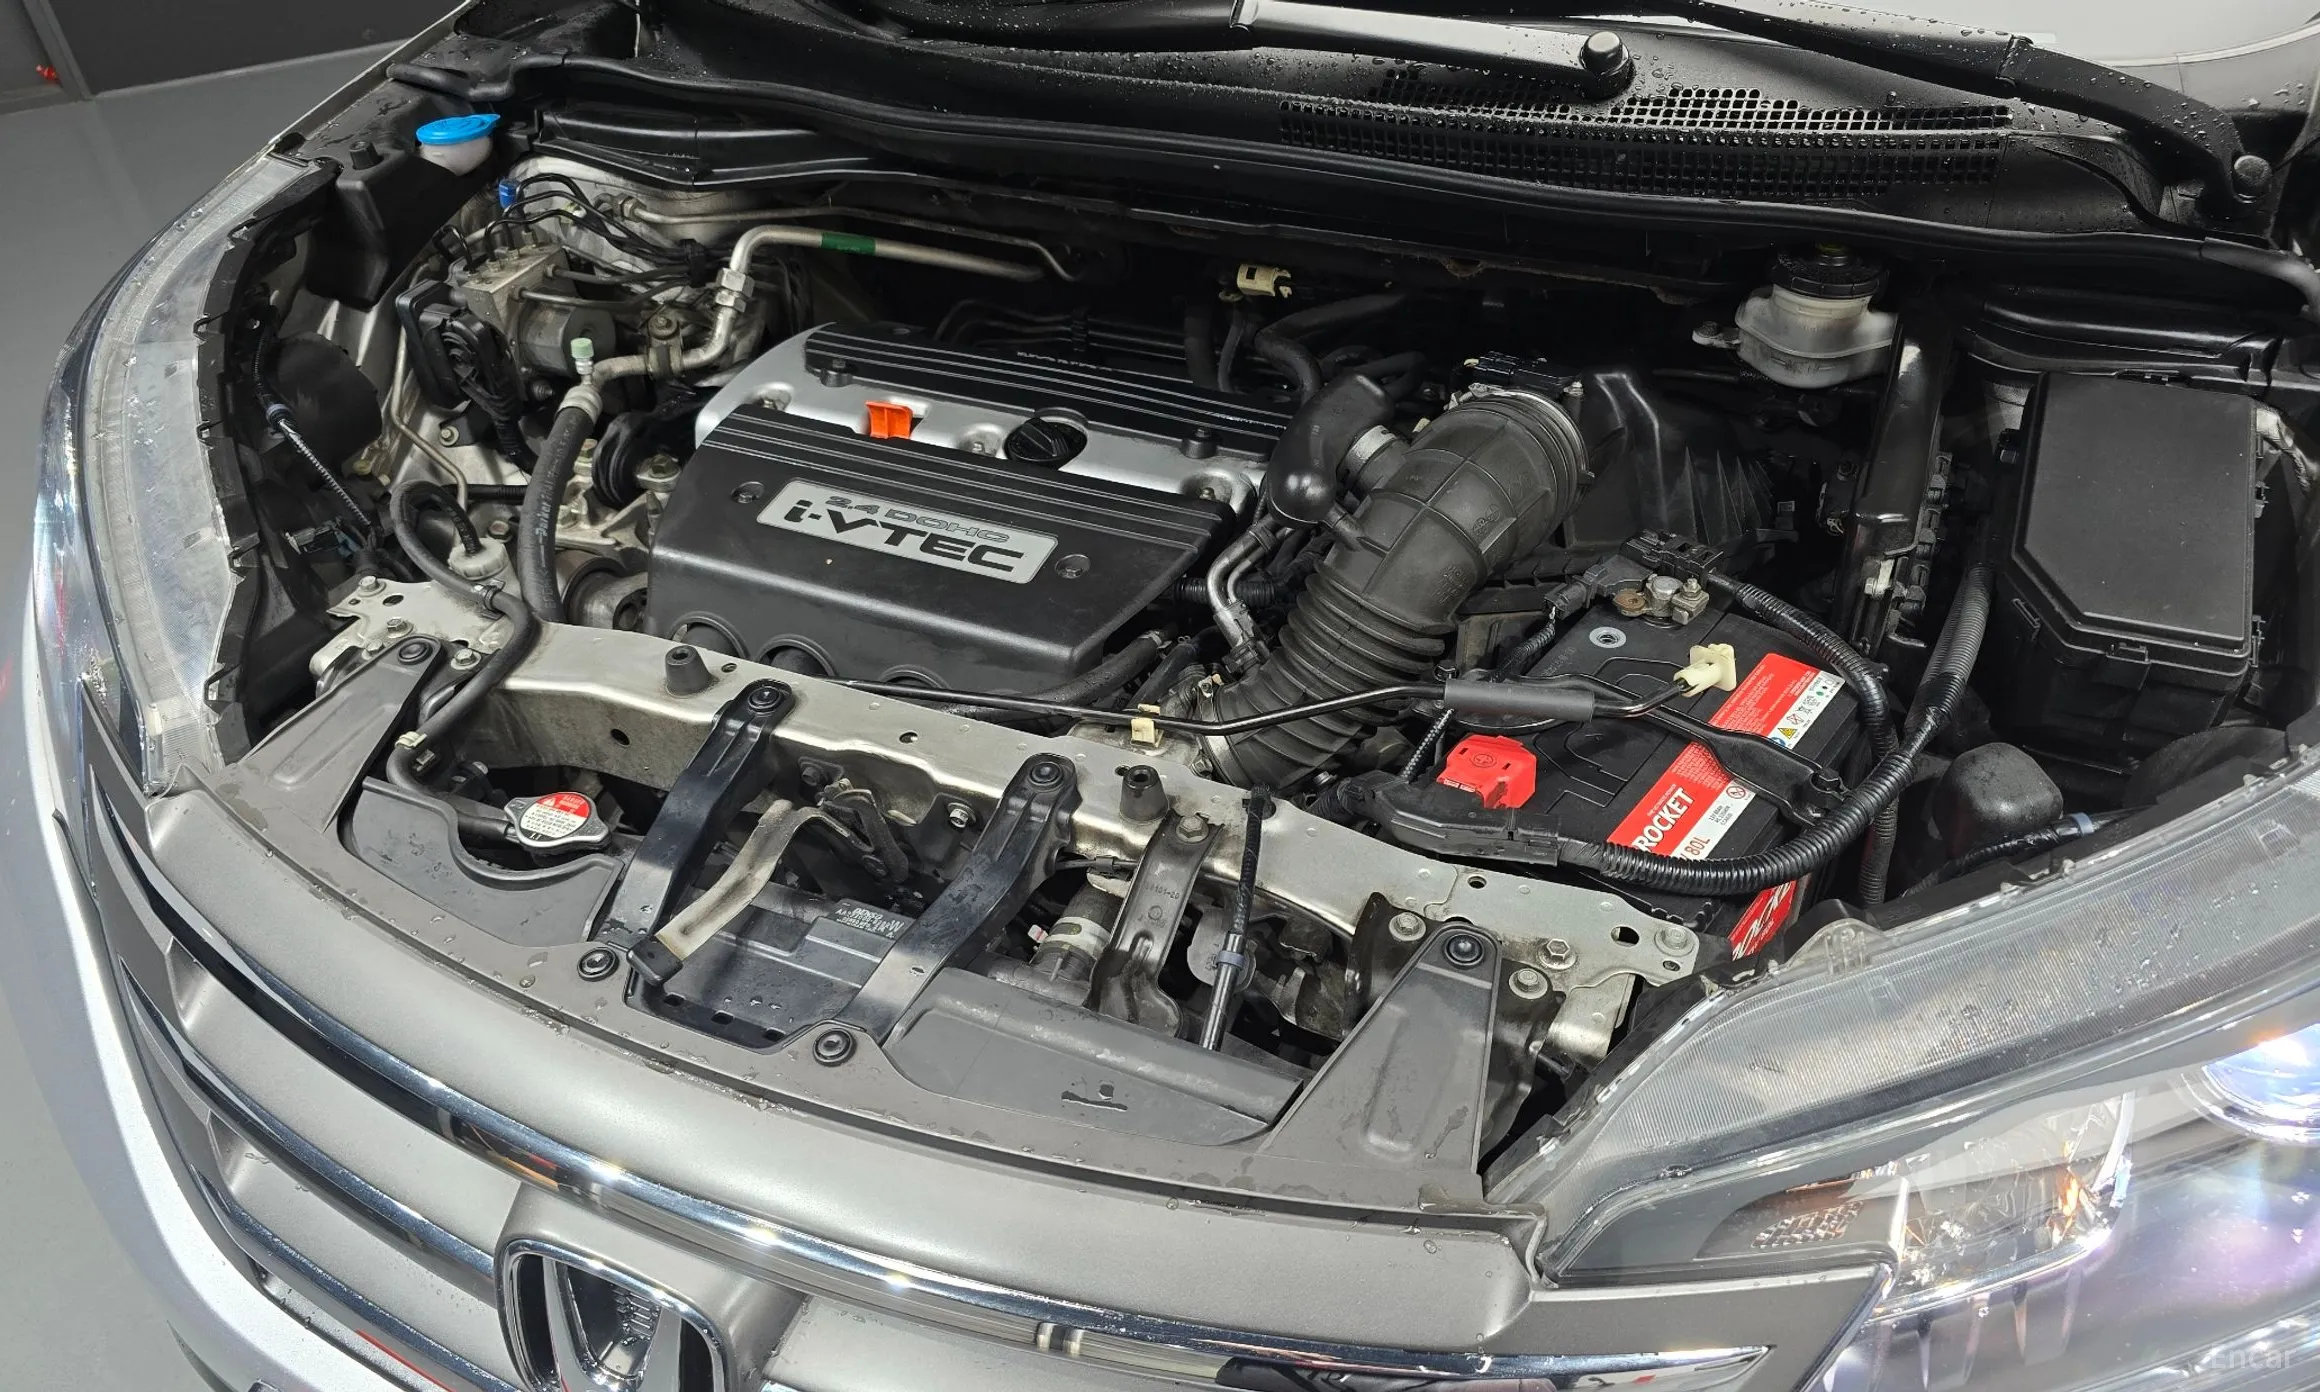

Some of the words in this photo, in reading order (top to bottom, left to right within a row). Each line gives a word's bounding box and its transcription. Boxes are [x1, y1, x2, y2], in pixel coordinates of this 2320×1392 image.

[784, 499, 1025, 572] i-VTEC
[885, 508, 1010, 542] DOHC
[1631, 787, 1696, 852] ROCKET
[1684, 836, 1710, 855] 80L
